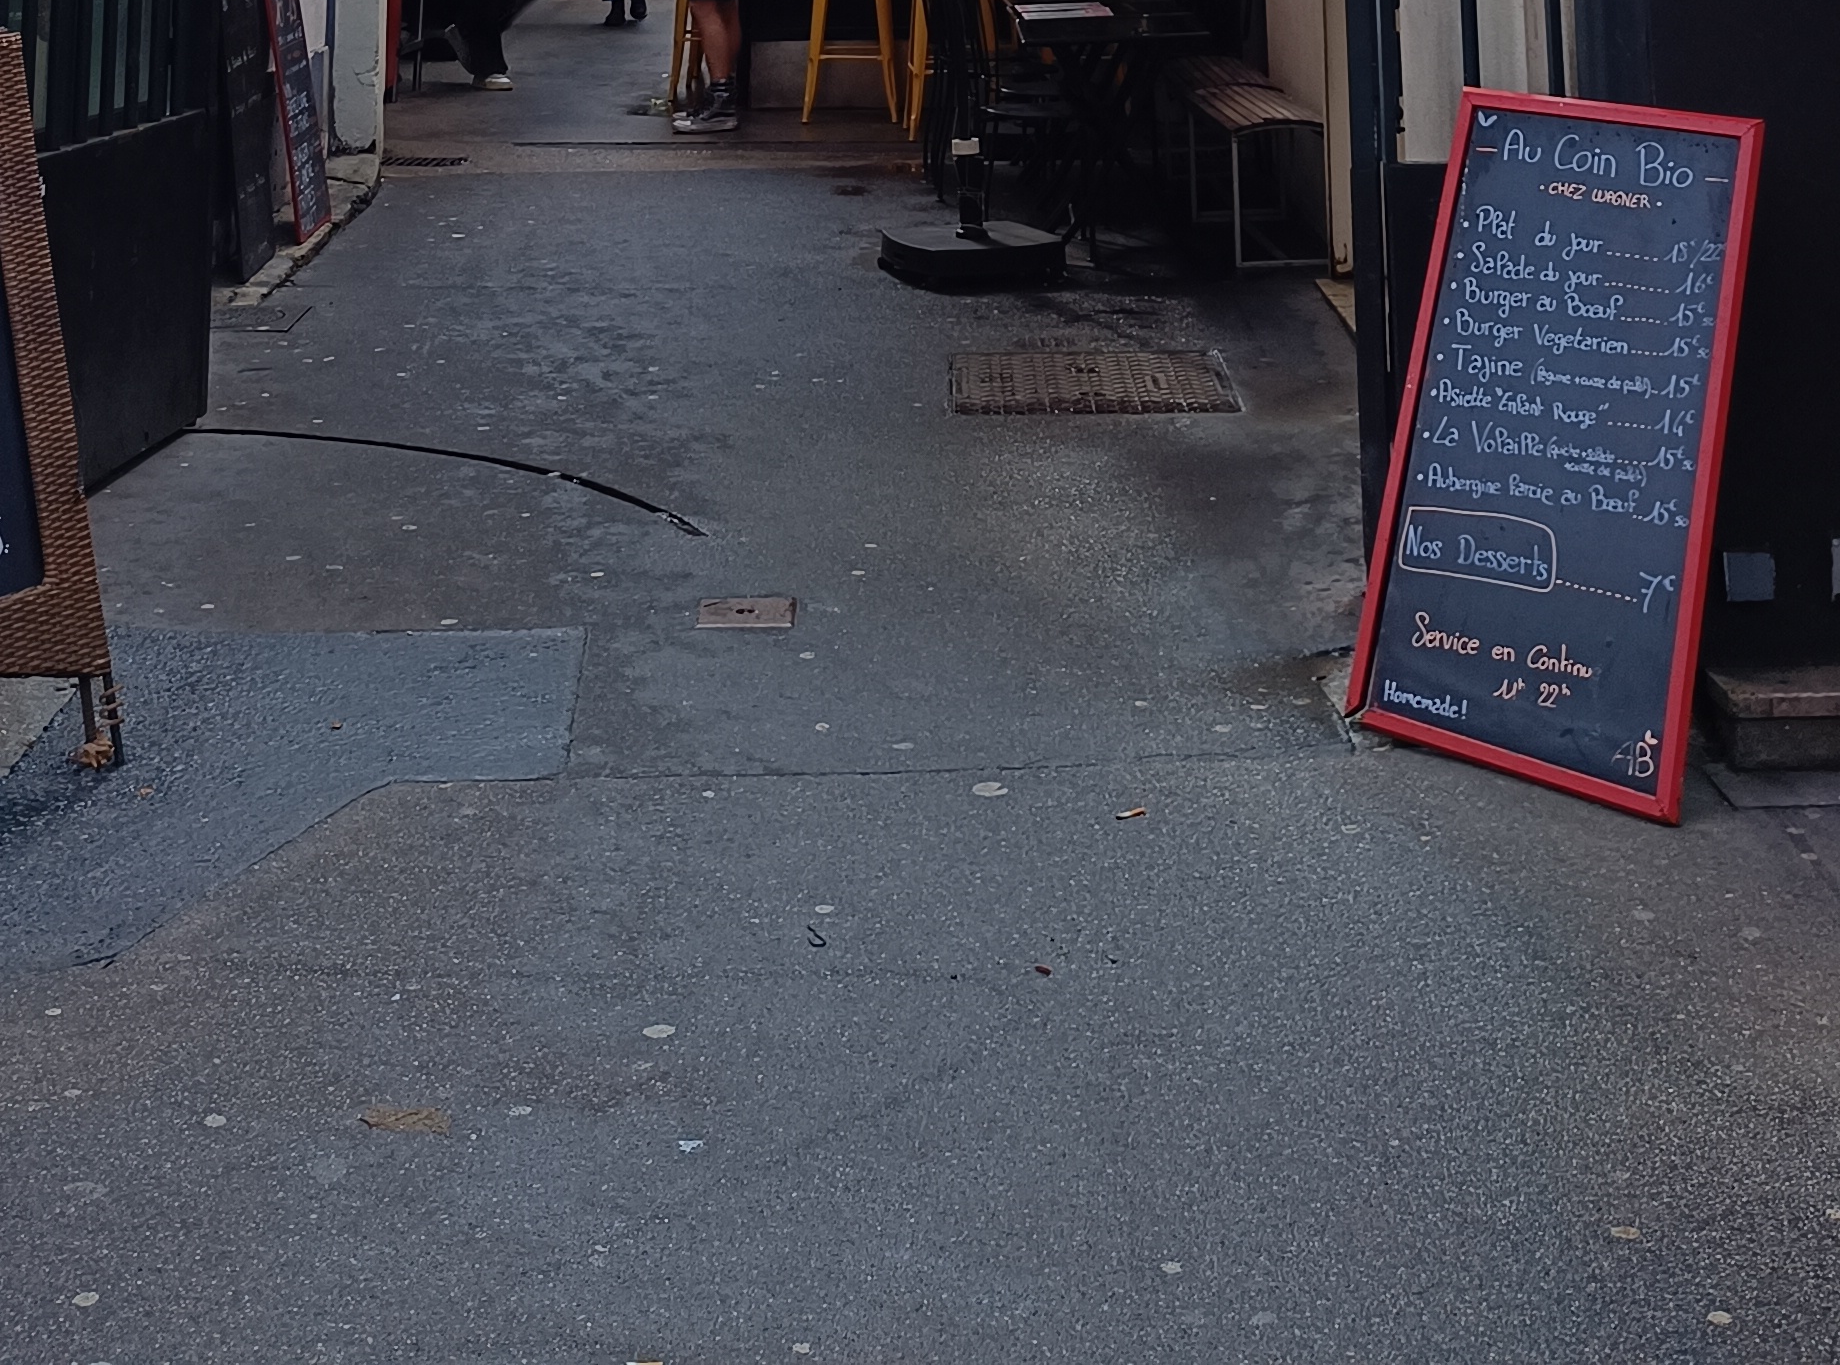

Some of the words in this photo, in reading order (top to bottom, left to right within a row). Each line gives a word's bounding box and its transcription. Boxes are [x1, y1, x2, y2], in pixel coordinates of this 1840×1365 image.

[1503, 129, 1542, 163] Au
[1554, 134, 1616, 178] Coin
[1635, 142, 1694, 188] Bio
[1548, 182, 1587, 200] CHEZ
[1591, 188, 1652, 209] WAGNER
[1476, 205, 1516, 239] Plat
[1535, 220, 1557, 247] du
[1562, 233, 1604, 261] jour
[1471, 241, 1535, 280] Salade
[1540, 262, 1560, 282] du
[1564, 270, 1603, 293] jour
[1464, 277, 1532, 318] Burger
[1536, 295, 1557, 312] au
[1456, 308, 1523, 347] Burger
[1451, 344, 1524, 383] Tajine
[1438, 379, 1492, 407] Asiette
[1432, 416, 1459, 447] La
[1471, 421, 1544, 456] Volaille
[1427, 462, 1502, 499] Aubergine
[1560, 489, 1582, 506] au
[1405, 524, 1443, 559] Nos
[1457, 534, 1548, 581] Desserts
[1411, 611, 1480, 655] Service
[1491, 645, 1515, 662] en
[1526, 643, 1593, 678] Continu
[1537, 682, 1571, 708] 22h
[1610, 740, 1655, 778] AB
